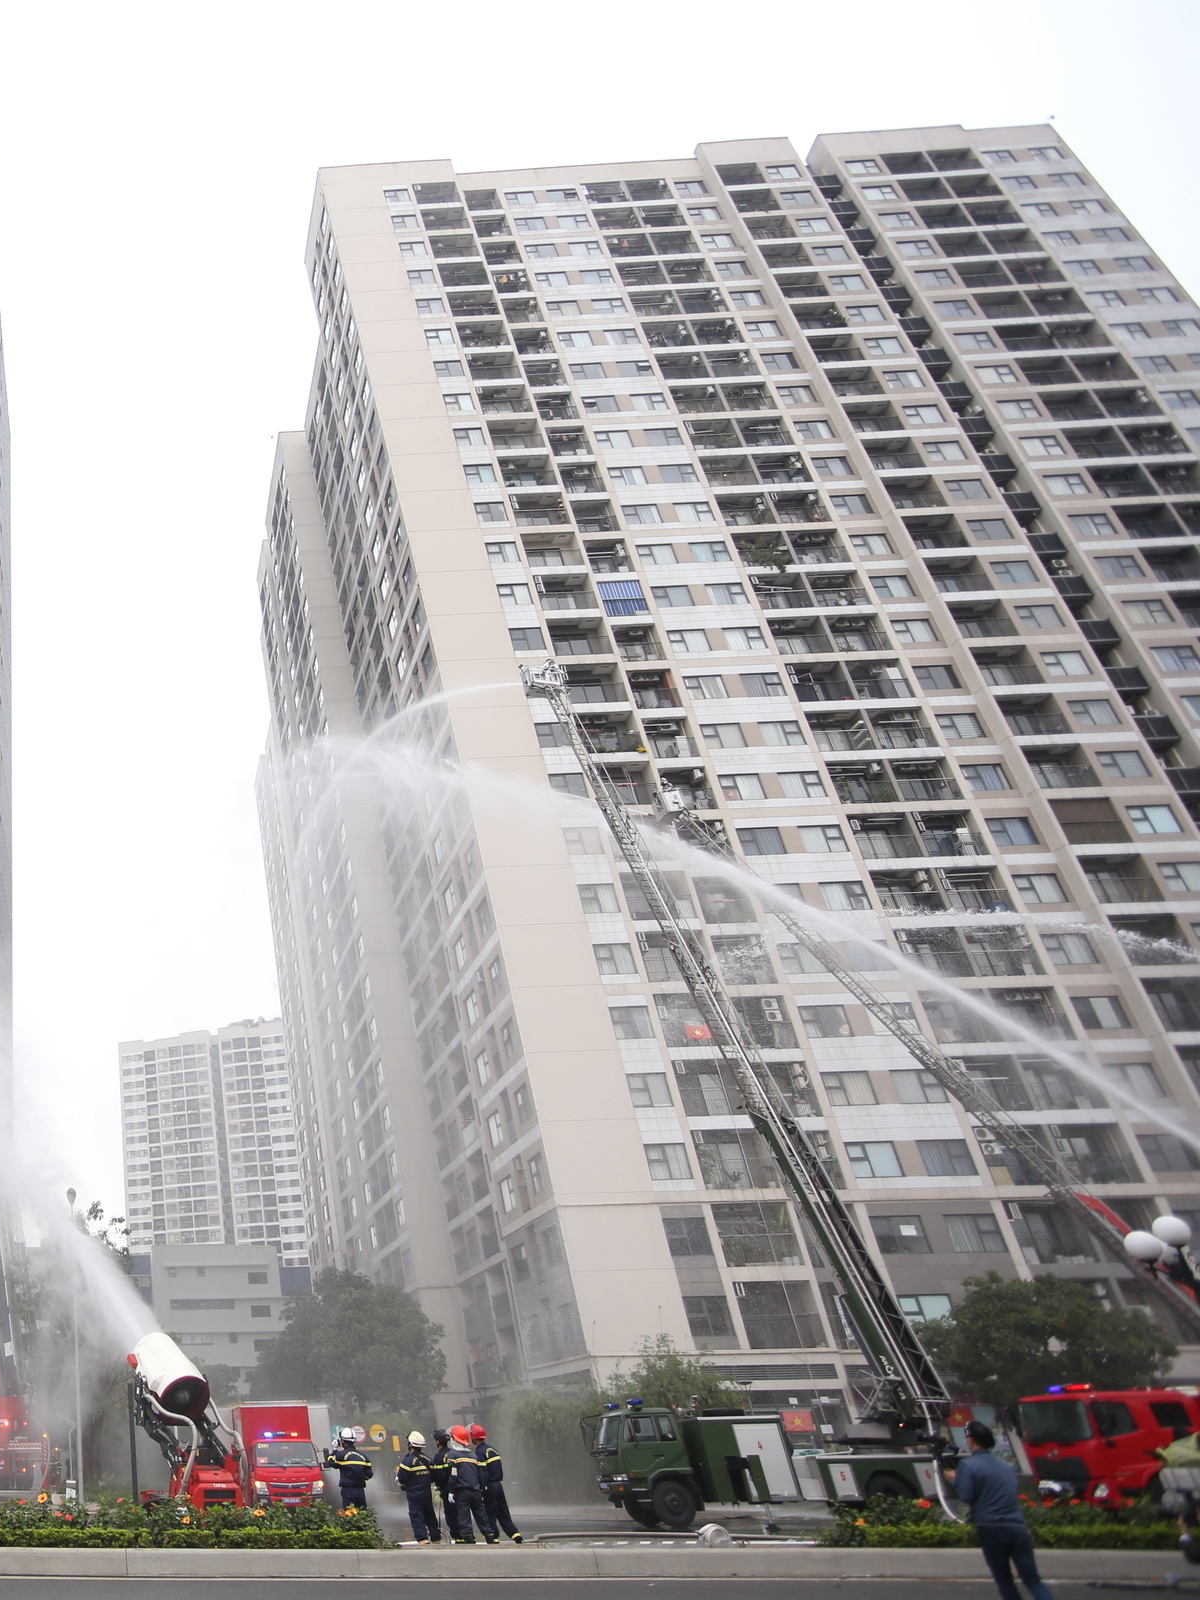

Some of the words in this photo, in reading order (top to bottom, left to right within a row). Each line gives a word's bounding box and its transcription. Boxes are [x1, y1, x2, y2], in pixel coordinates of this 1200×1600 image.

[757, 1440, 763, 1450] 4
[840, 1471, 846, 1481] 5
[925, 1469, 932, 1480] 6
